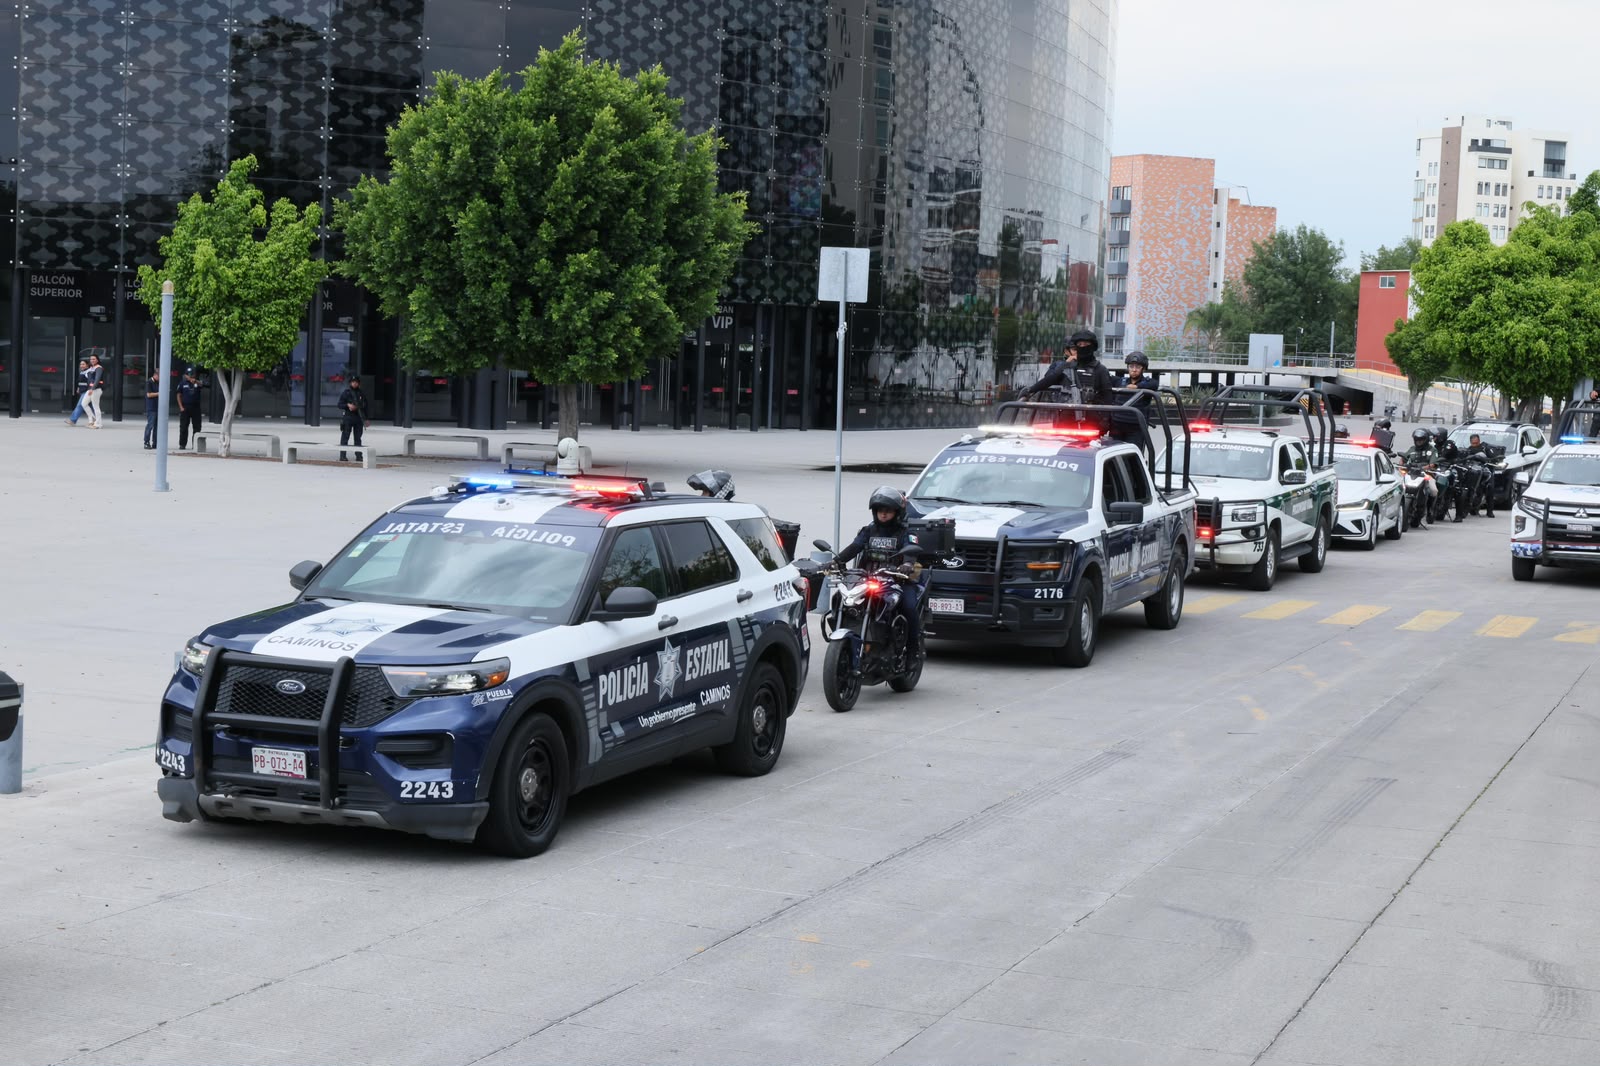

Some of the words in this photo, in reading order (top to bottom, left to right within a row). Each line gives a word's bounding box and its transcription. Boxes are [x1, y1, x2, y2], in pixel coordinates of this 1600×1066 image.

[31, 274, 75, 285] BALCÓN
[30, 287, 82, 298] SUPERIOR
[712, 315, 734, 329] VIP
[1253, 541, 1264, 553] 733
[773, 580, 793, 602] 2243
[1034, 588, 1064, 599] 2176
[267, 635, 358, 652] CAMINOS
[598, 656, 649, 709] POLICÍA
[685, 638, 731, 681] ESTATAL
[486, 688, 513, 698] PUEBLA
[700, 684, 731, 706] CAMINOS
[160, 748, 186, 772] 2243
[253, 754, 304, 772] PB-073-A4
[400, 780, 454, 798] 2243
